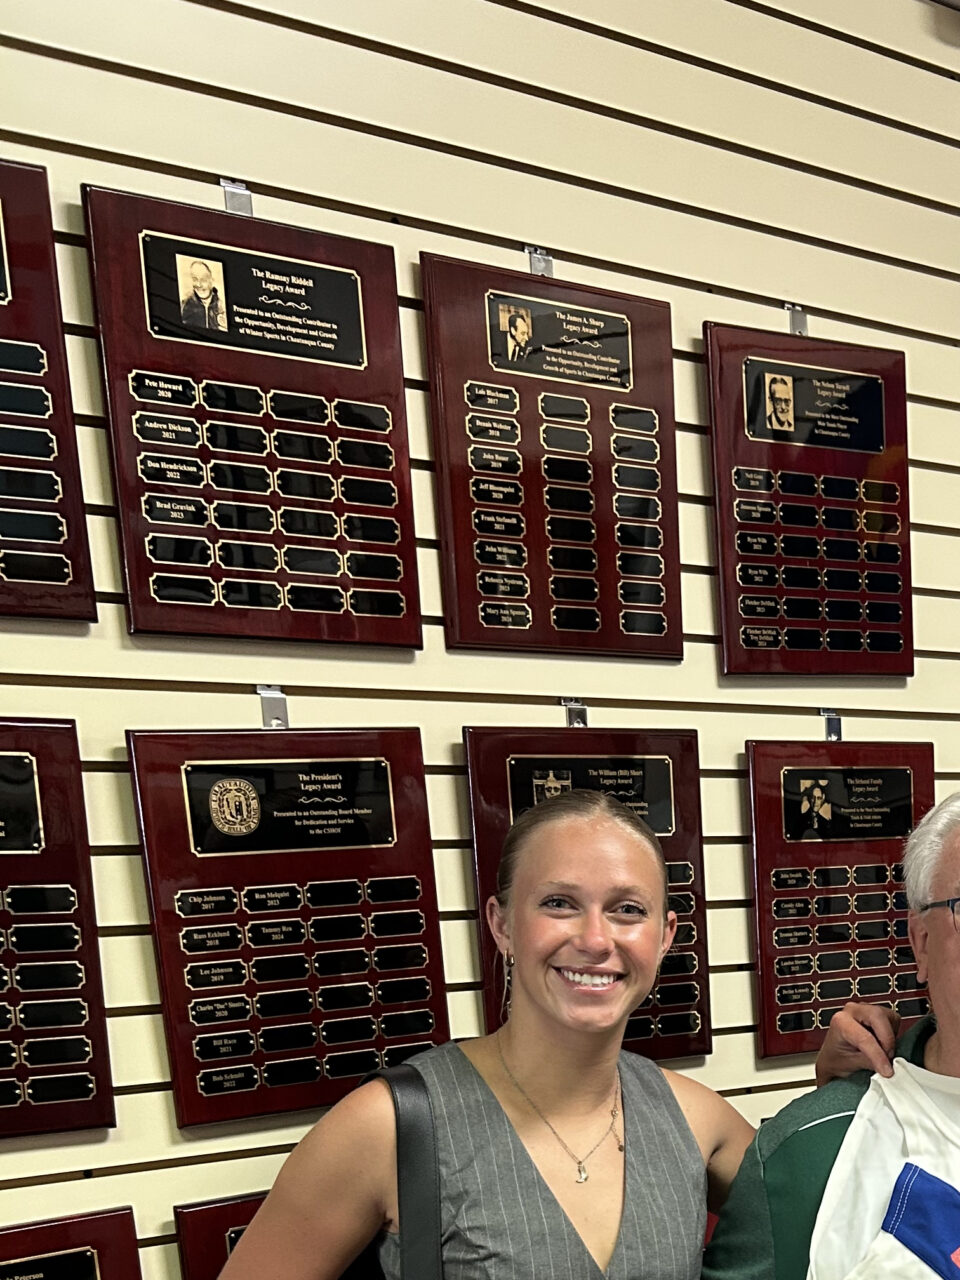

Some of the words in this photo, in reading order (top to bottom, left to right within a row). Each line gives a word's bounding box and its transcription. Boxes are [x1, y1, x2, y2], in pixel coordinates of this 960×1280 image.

[251, 268, 264, 278] The
[262, 280, 284, 293] Legacy
[284, 285, 306, 296] Award
[555, 311, 566, 319] The
[563, 322, 580, 333] Legacy
[582, 326, 598, 335] Award
[144, 420, 167, 429] Andrew
[162, 431, 176, 439] 2021
[300, 783, 321, 792] Legacy
